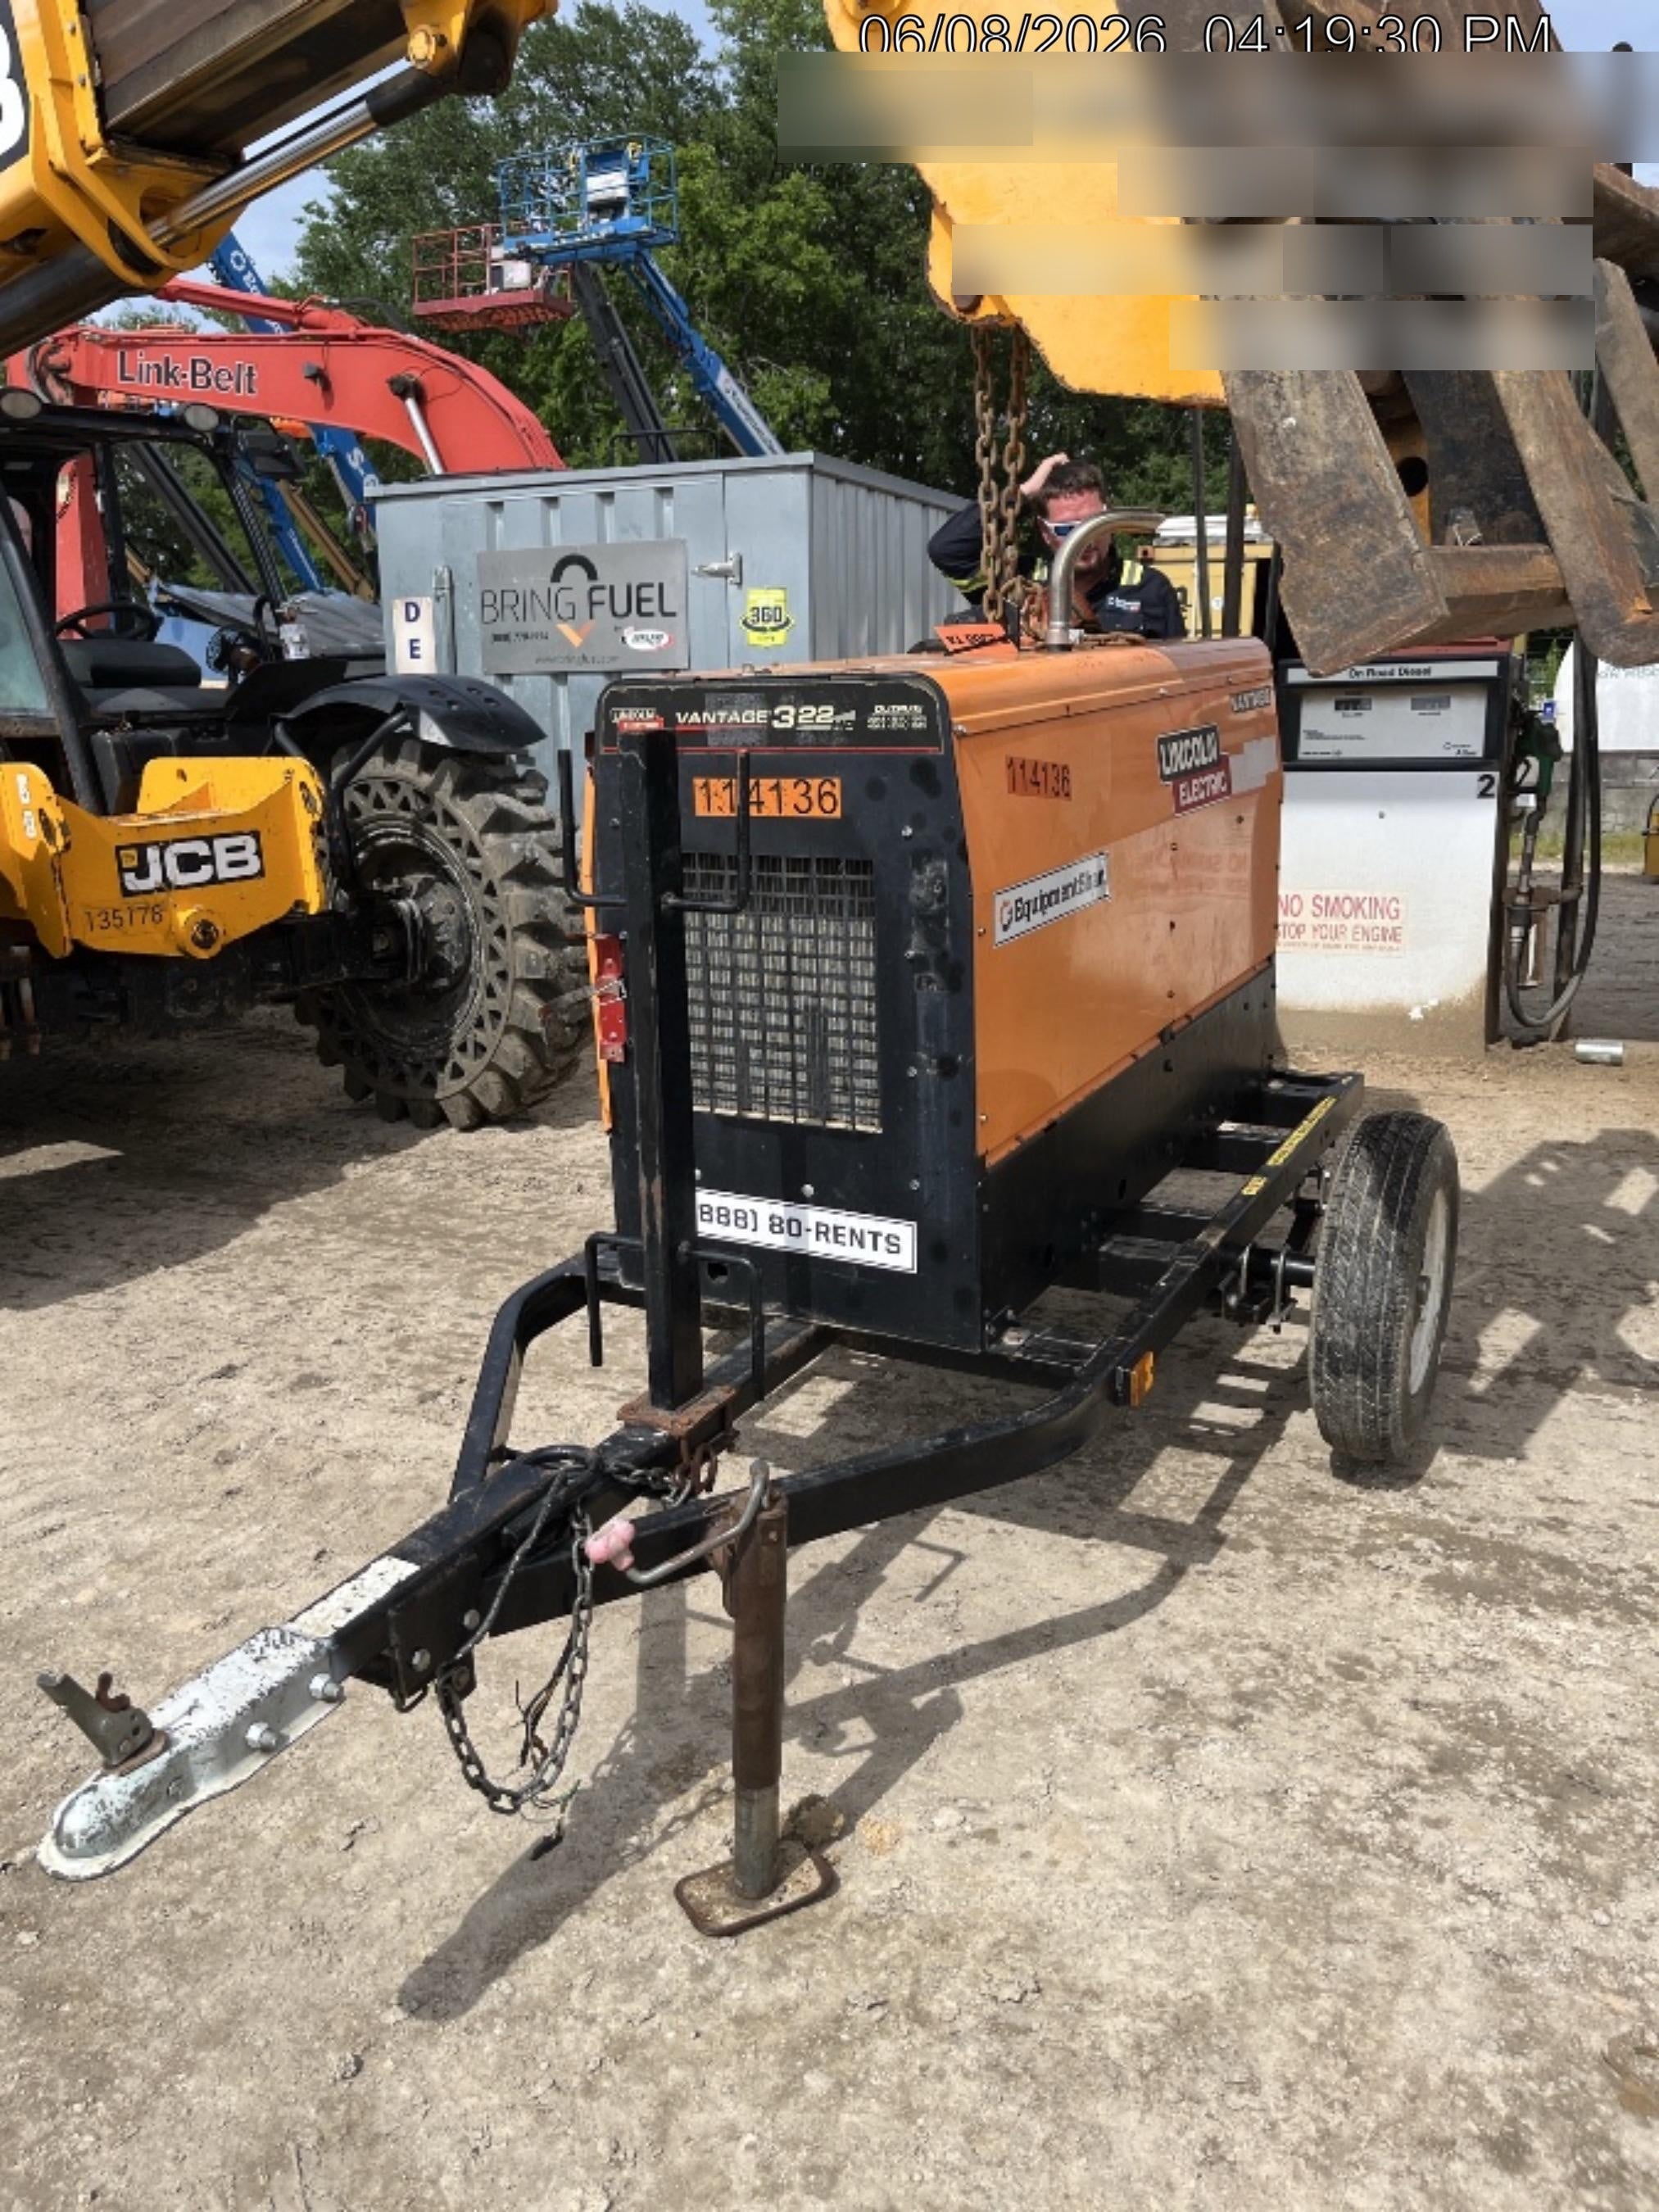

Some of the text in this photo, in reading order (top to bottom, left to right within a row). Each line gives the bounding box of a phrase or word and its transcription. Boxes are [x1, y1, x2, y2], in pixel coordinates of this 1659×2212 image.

[117, 350, 257, 396] Link-Belt
[481, 581, 678, 624] BRING FUEL
[675, 709, 768, 724] VANTAGE
[1159, 732, 1218, 775] LINCOLN
[1007, 756, 1071, 798] 114136
[1178, 770, 1228, 807] ELECTRIC
[1476, 773, 1496, 800] 2
[698, 778, 839, 814] 114136
[123, 835, 261, 891] JCB
[1278, 894, 1400, 920] NO SMOKING
[1312, 923, 1347, 941] YOUR
[1352, 926, 1403, 943] ENGINE
